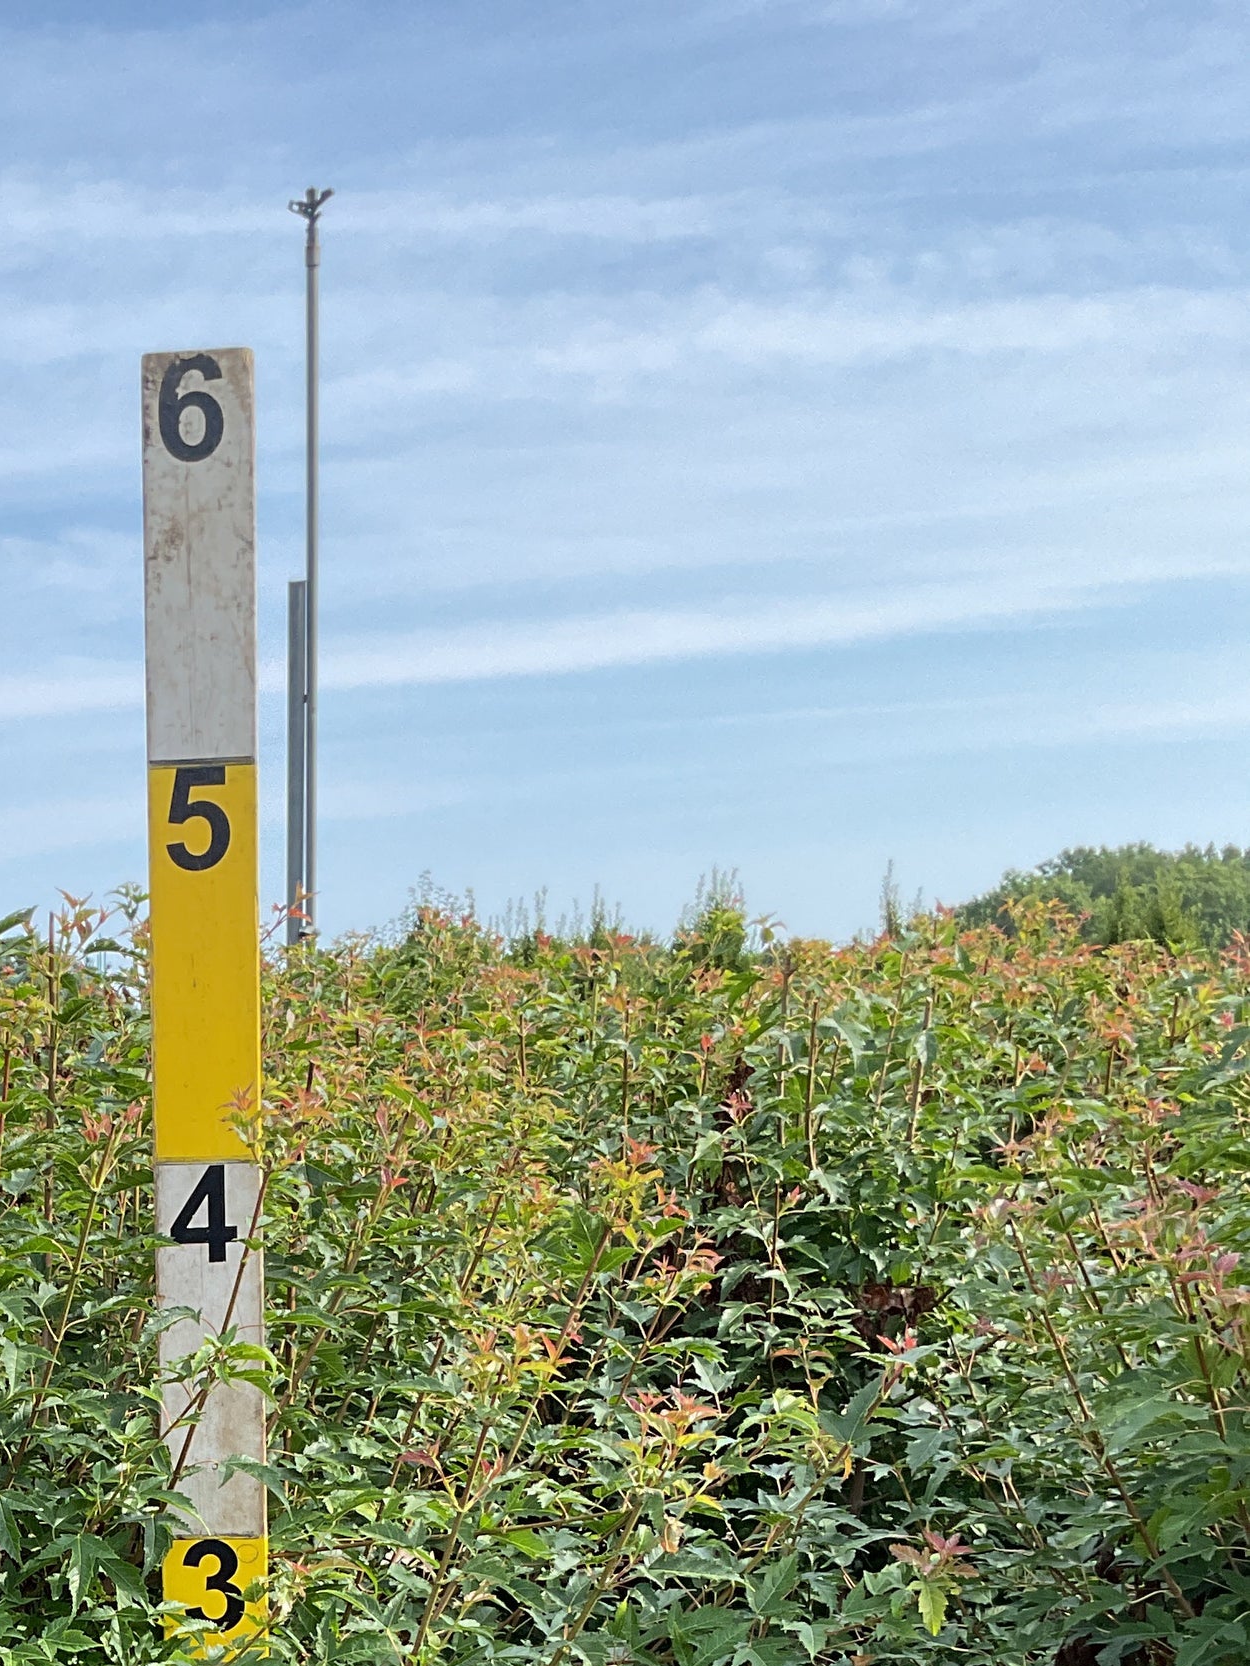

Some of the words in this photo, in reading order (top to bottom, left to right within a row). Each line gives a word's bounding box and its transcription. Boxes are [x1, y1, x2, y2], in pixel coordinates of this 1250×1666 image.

[158, 353, 224, 462] 6
[166, 766, 230, 871] 5
[170, 1165, 237, 1262] 4
[183, 1539, 245, 1633] 3
